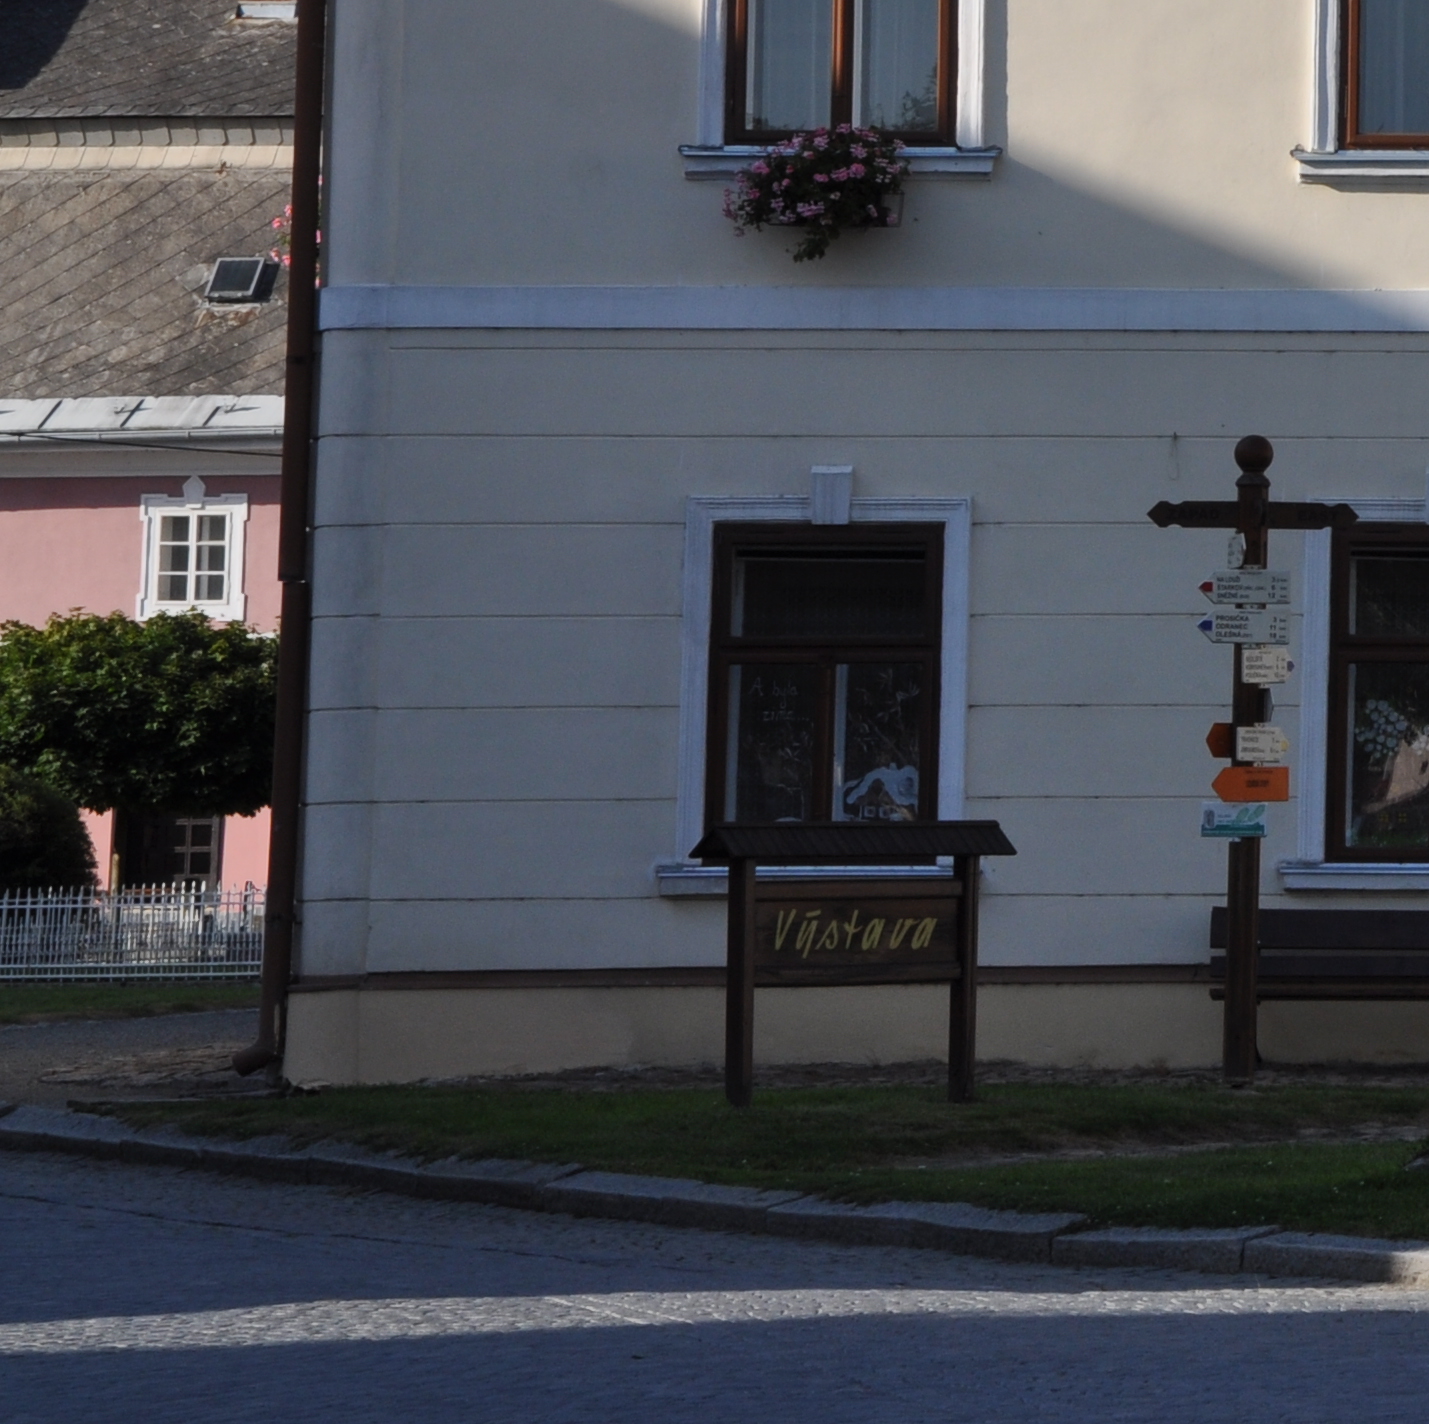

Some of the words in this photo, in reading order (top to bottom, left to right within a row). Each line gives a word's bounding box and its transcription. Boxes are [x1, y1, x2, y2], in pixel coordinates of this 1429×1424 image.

[748, 676, 764, 697] A
[772, 680, 799, 709] byla
[775, 909, 937, 959] Výstava
